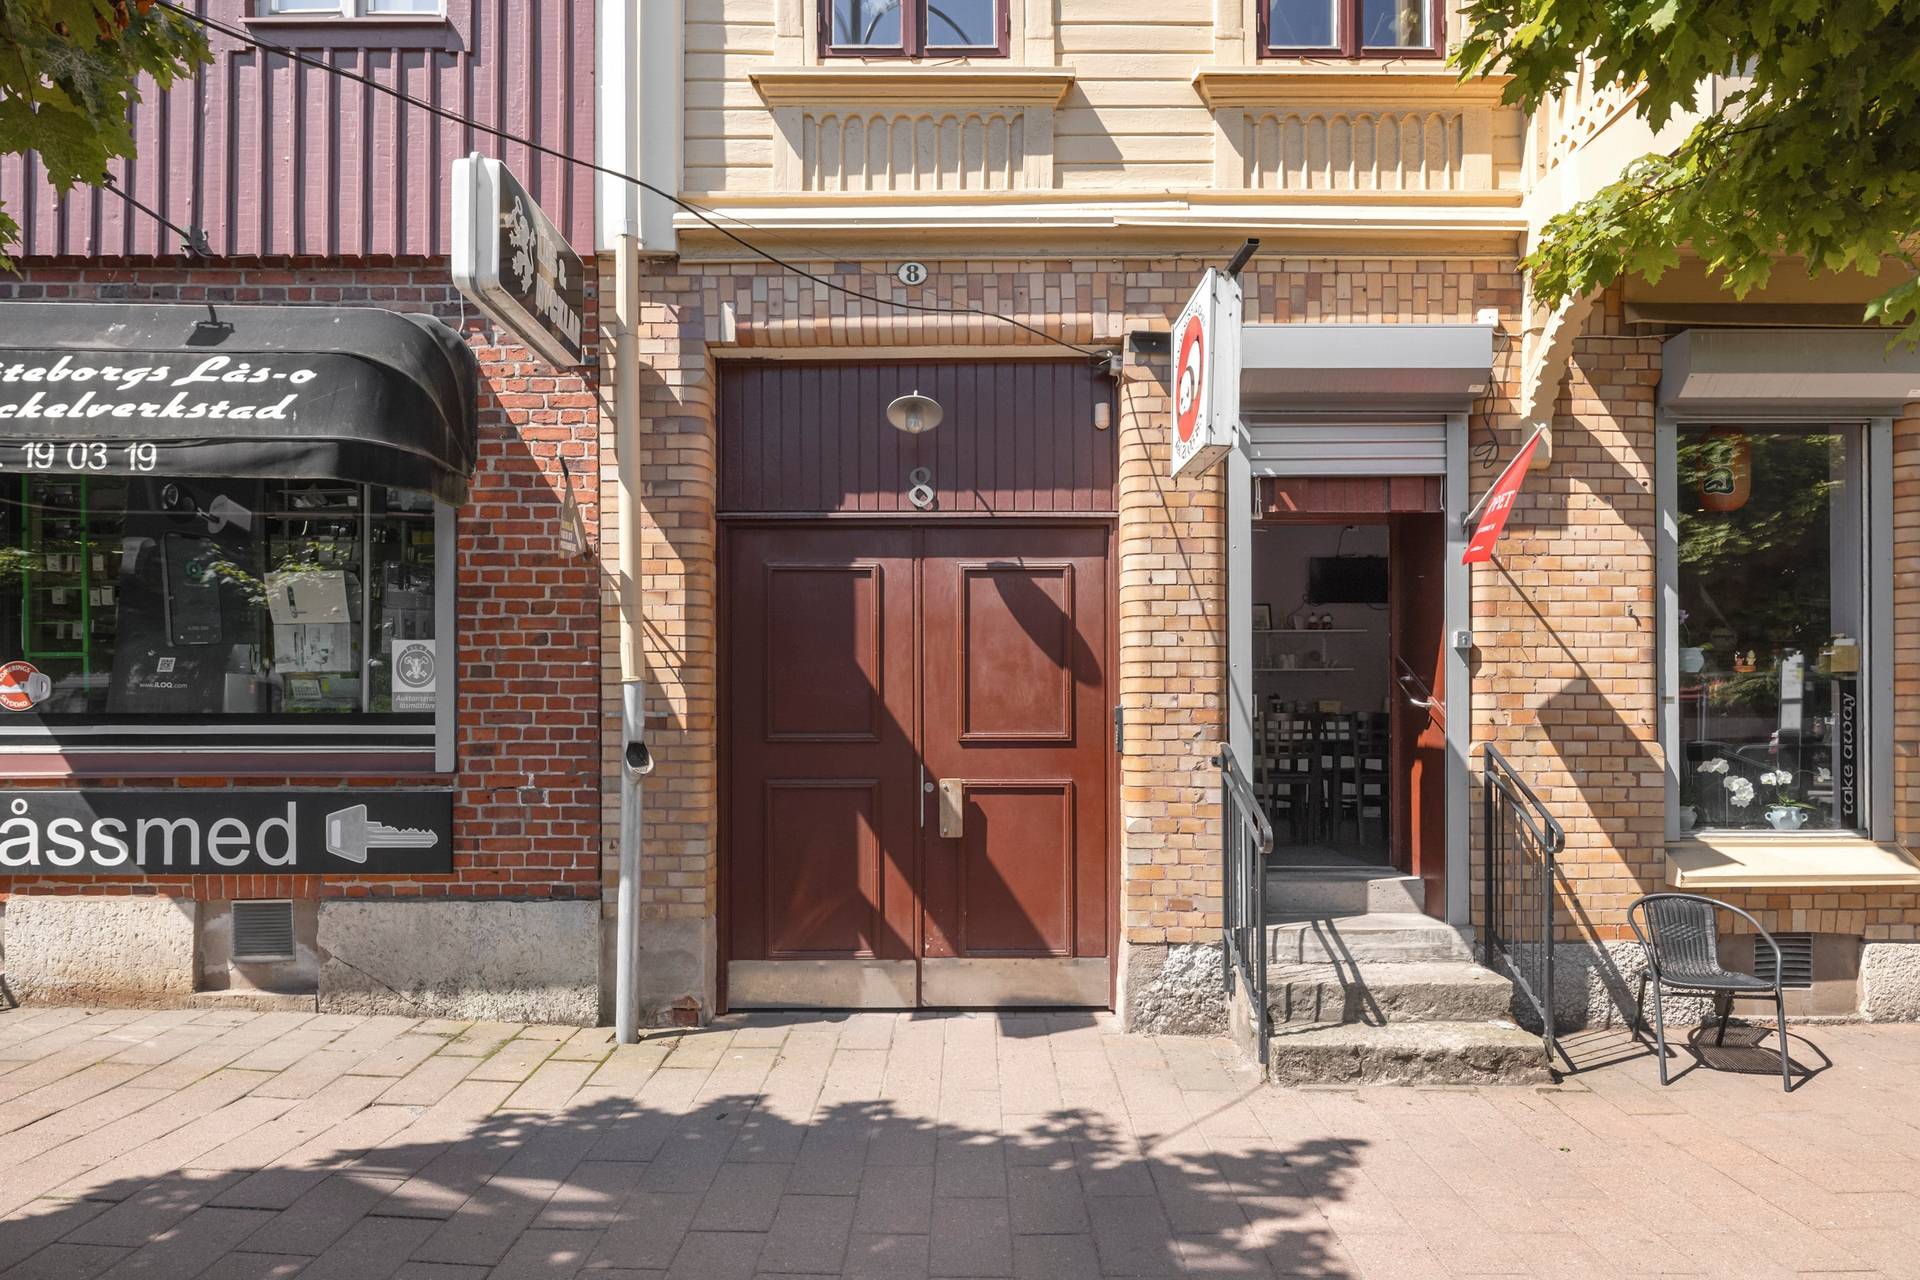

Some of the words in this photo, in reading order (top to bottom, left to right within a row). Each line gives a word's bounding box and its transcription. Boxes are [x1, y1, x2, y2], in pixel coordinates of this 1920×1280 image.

[558, 258, 567, 290] &
[906, 264, 920, 282] 8
[21, 442, 55, 469] 19
[66, 442, 107, 470] 03
[124, 442, 157, 471] 19
[908, 467, 934, 508] 8
[140, 681, 188, 689] www.iLOQ.com
[1842, 692, 1856, 760] away
[1841, 764, 1854, 816] take
[0, 798, 297, 867] åssmed
